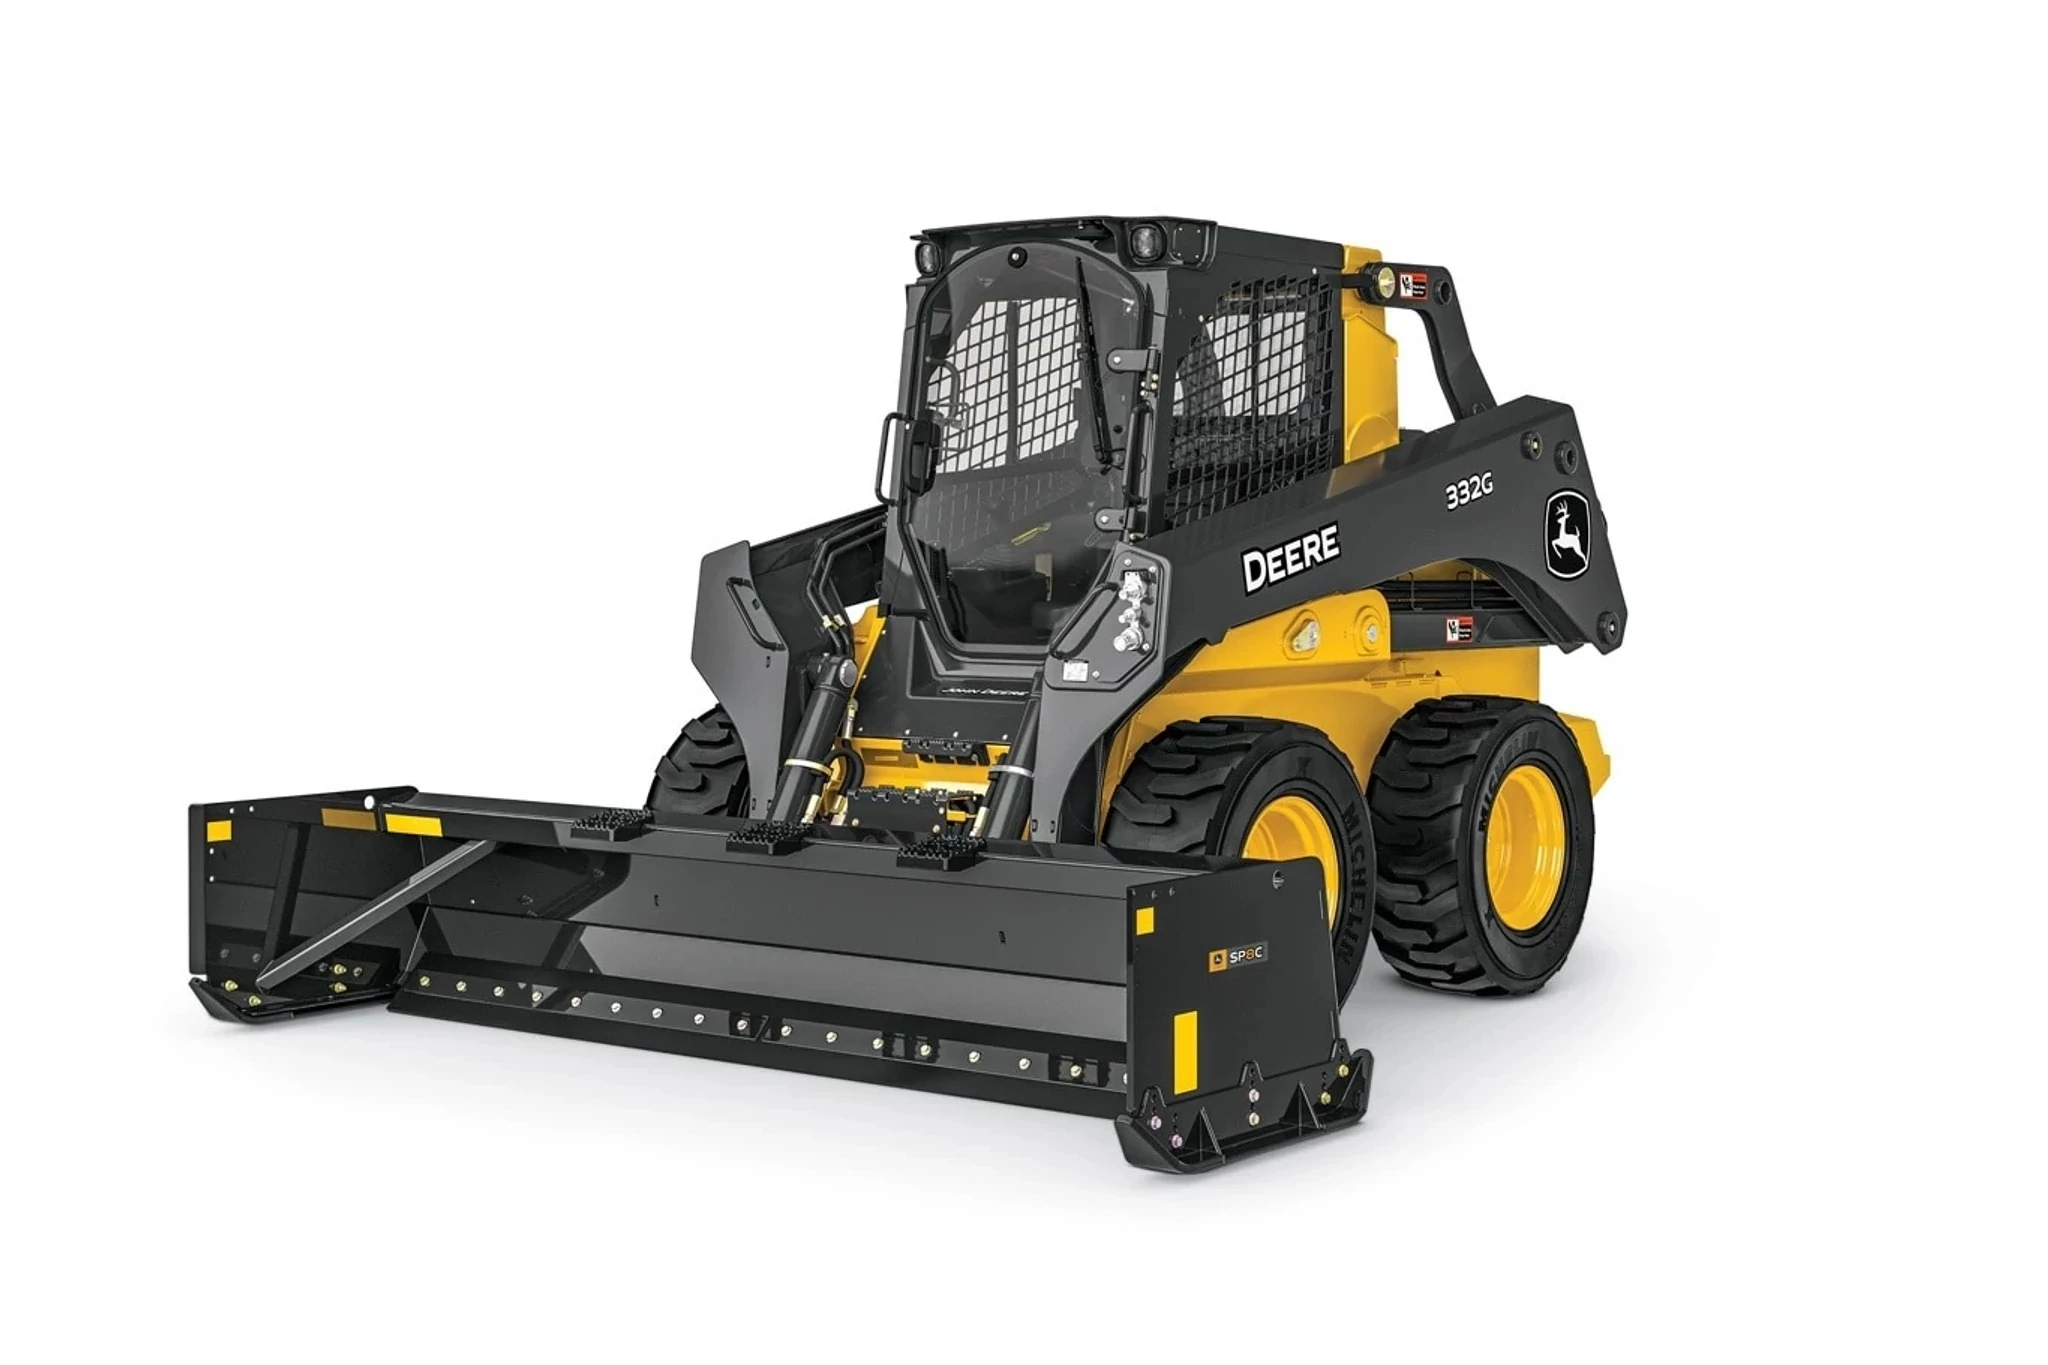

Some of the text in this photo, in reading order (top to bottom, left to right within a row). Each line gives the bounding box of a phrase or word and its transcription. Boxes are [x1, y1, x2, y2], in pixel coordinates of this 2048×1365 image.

[1445, 471, 1493, 510] 332G
[1242, 524, 1340, 593] DEERE
[1338, 801, 1368, 966] MICHELIN
[1229, 946, 1263, 964] SP8C
